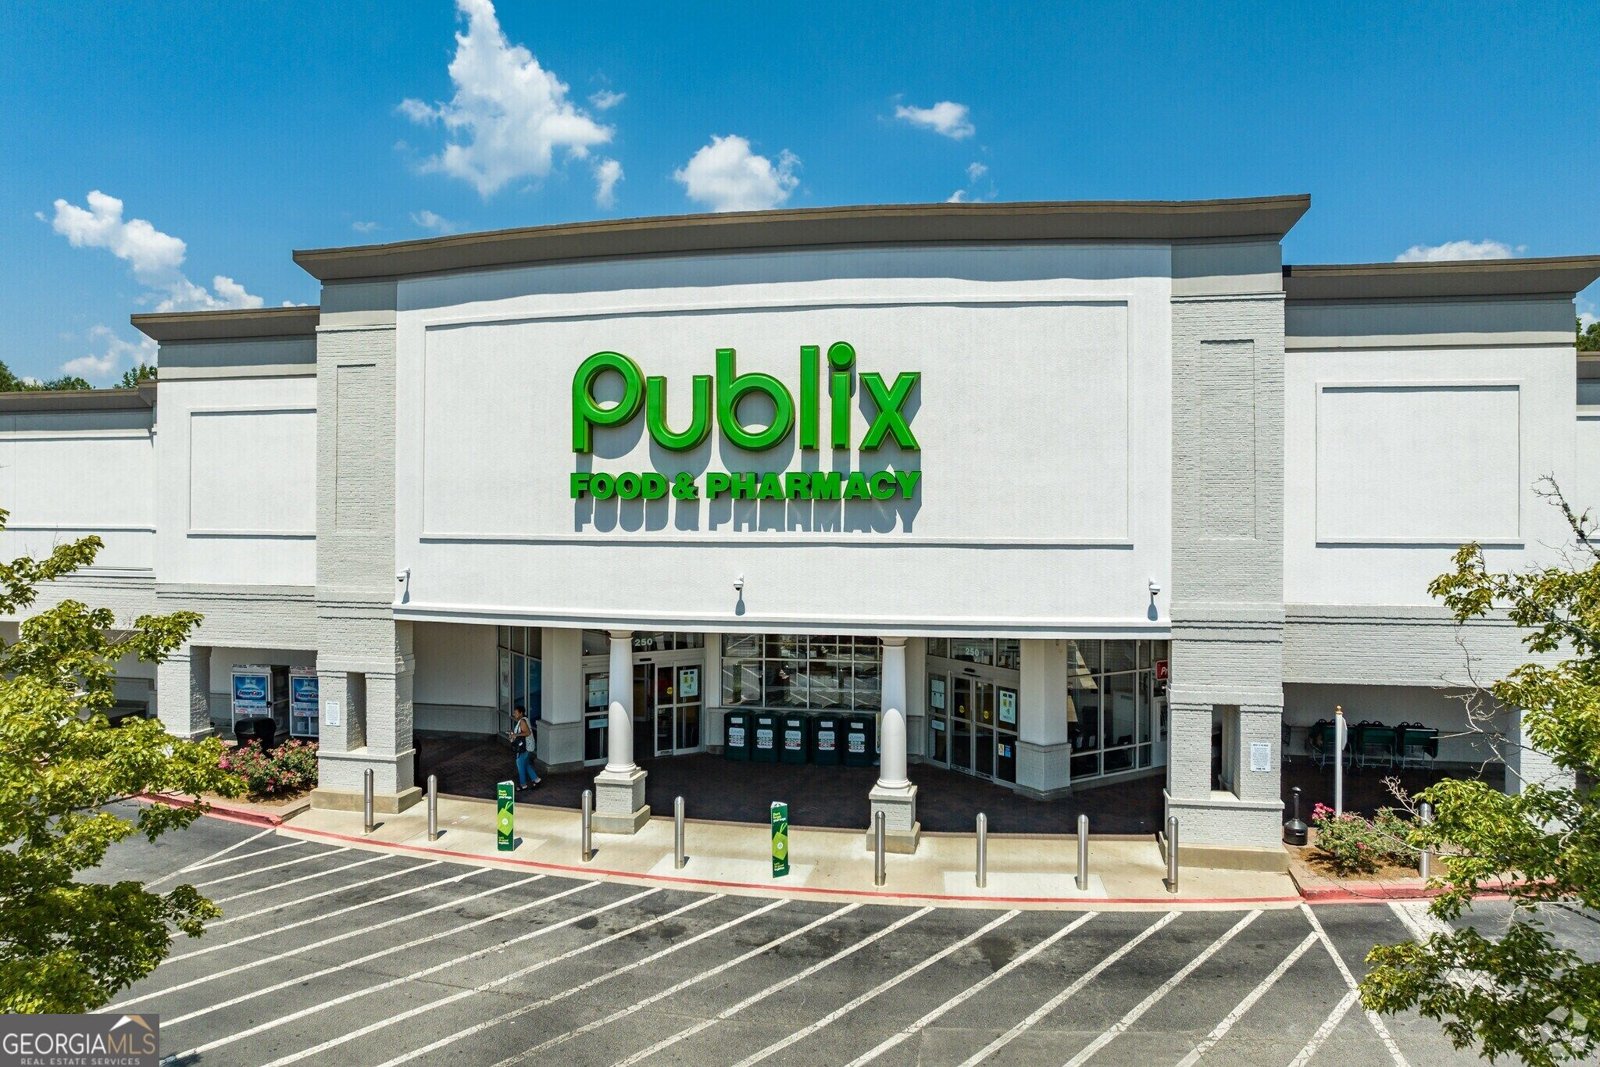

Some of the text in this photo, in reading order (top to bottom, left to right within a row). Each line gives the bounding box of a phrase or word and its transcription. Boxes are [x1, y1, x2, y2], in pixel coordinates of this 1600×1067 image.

[572, 341, 922, 453] Publix
[570, 470, 922, 501] FOOD & PHARMACY
[634, 638, 653, 647] 250
[965, 648, 979, 656] 250
